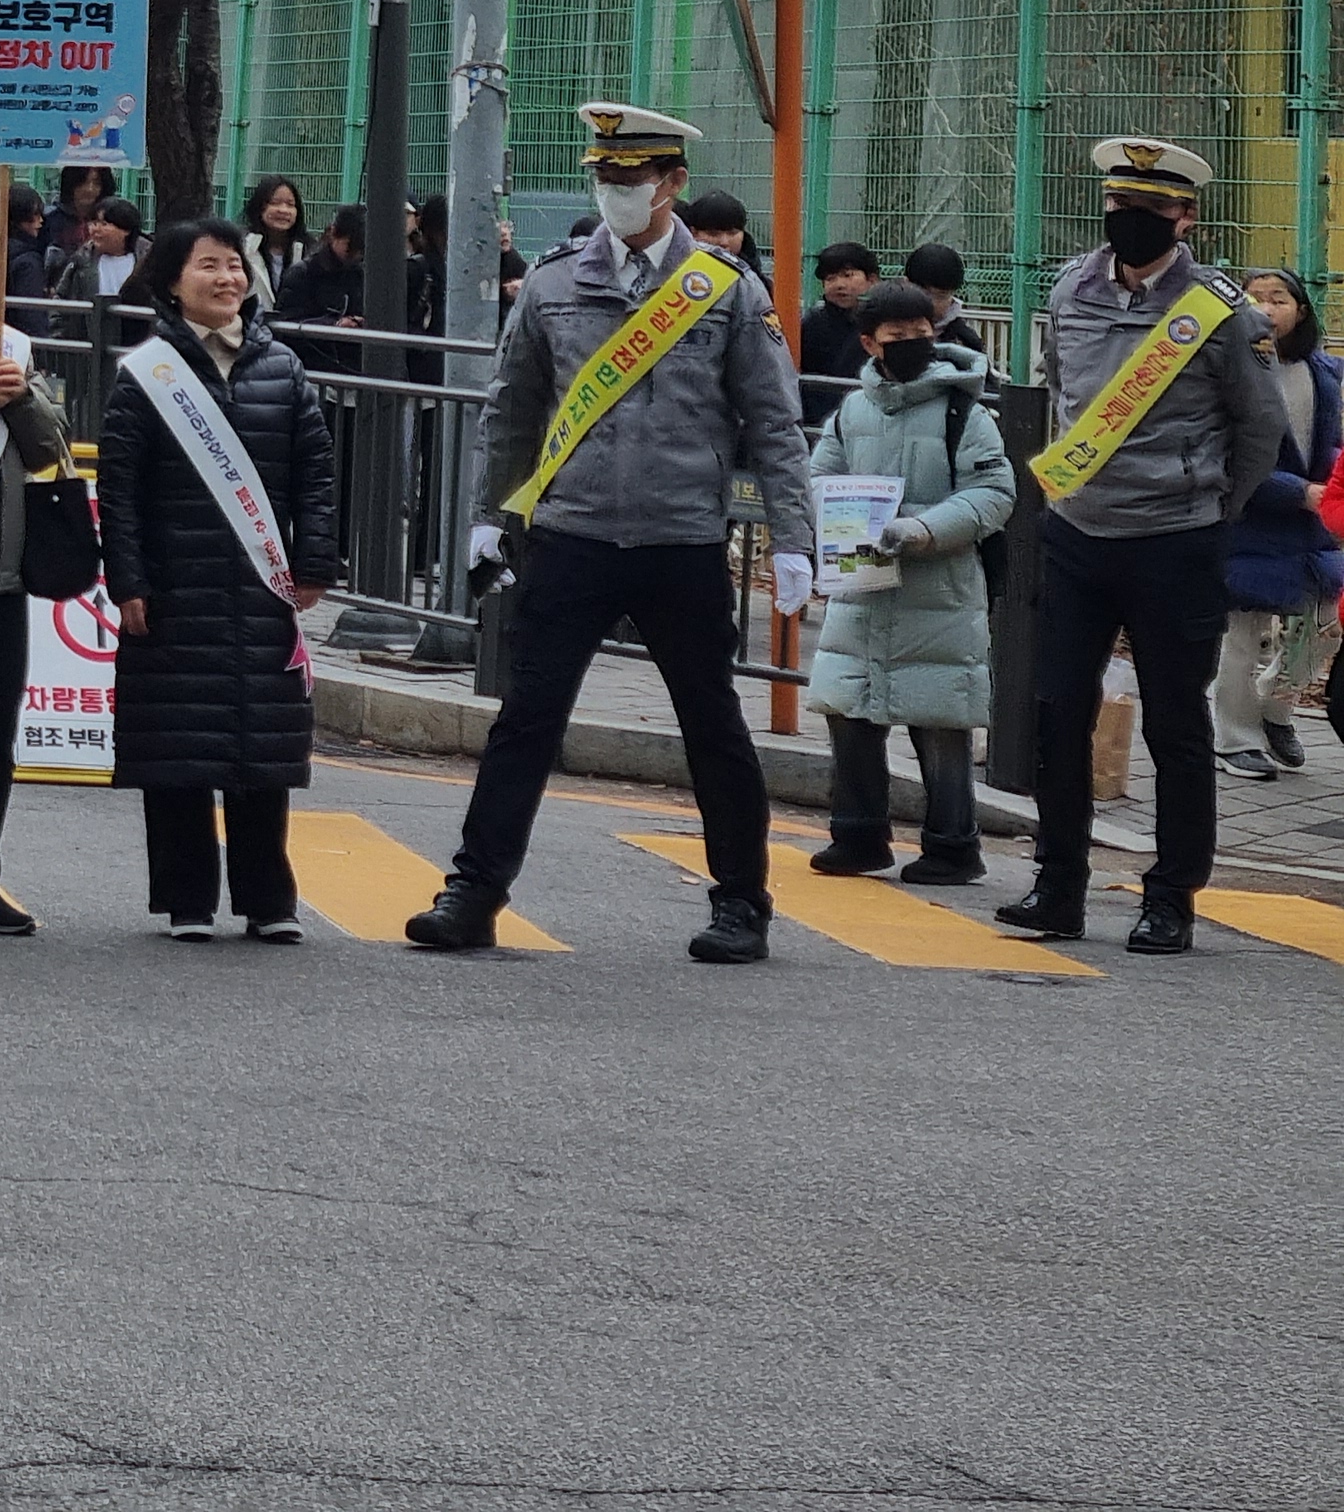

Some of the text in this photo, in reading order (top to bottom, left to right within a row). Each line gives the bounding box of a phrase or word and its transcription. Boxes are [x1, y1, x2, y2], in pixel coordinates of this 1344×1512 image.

[60, 41, 115, 71] OUT
[24, 726, 63, 748] 협조
[69, 728, 106, 751] 부탁
